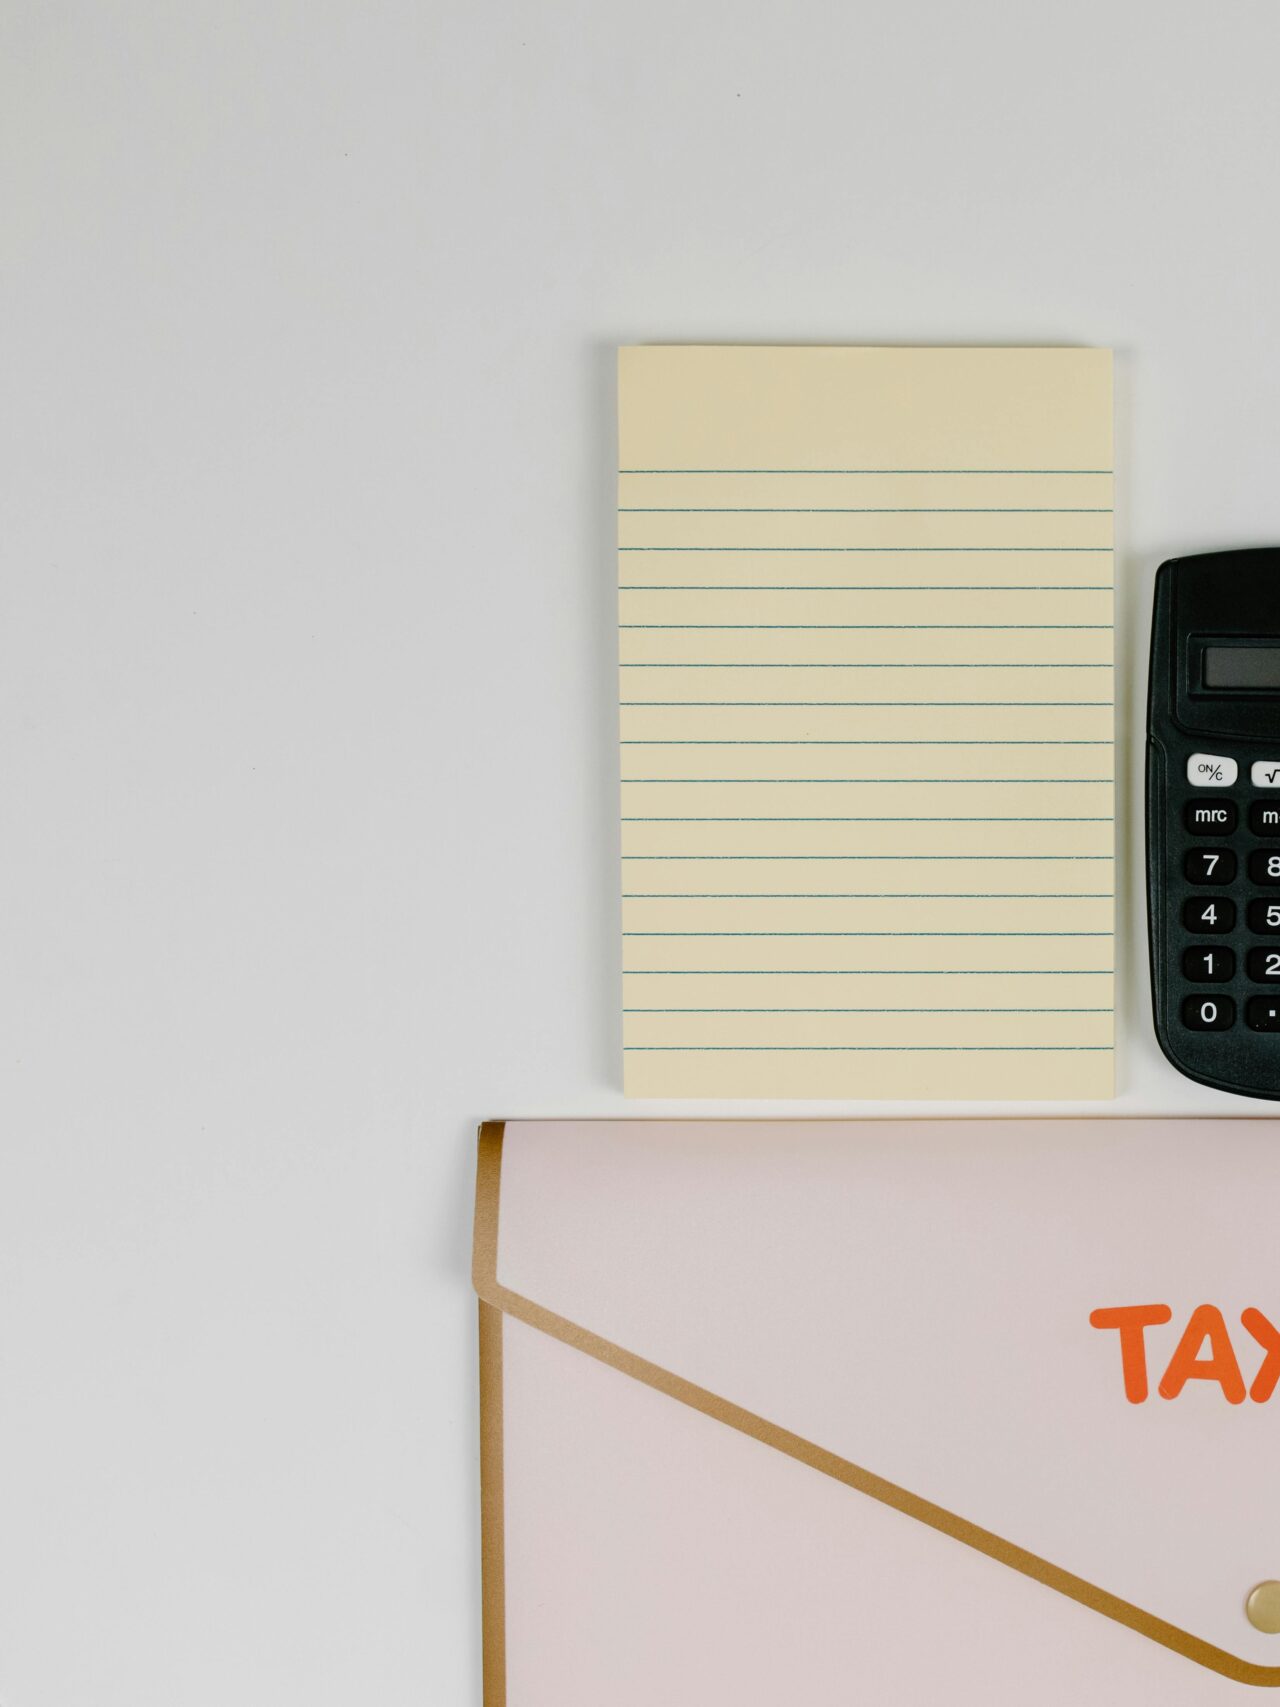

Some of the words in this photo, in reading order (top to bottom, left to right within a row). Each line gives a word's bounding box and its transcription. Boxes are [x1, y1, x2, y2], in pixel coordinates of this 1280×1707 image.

[1195, 809, 1227, 823] mrc
[1202, 854, 1220, 876] 7
[1201, 904, 1218, 925] 4
[1203, 953, 1213, 975] 1
[1200, 1002, 1217, 1023] 0
